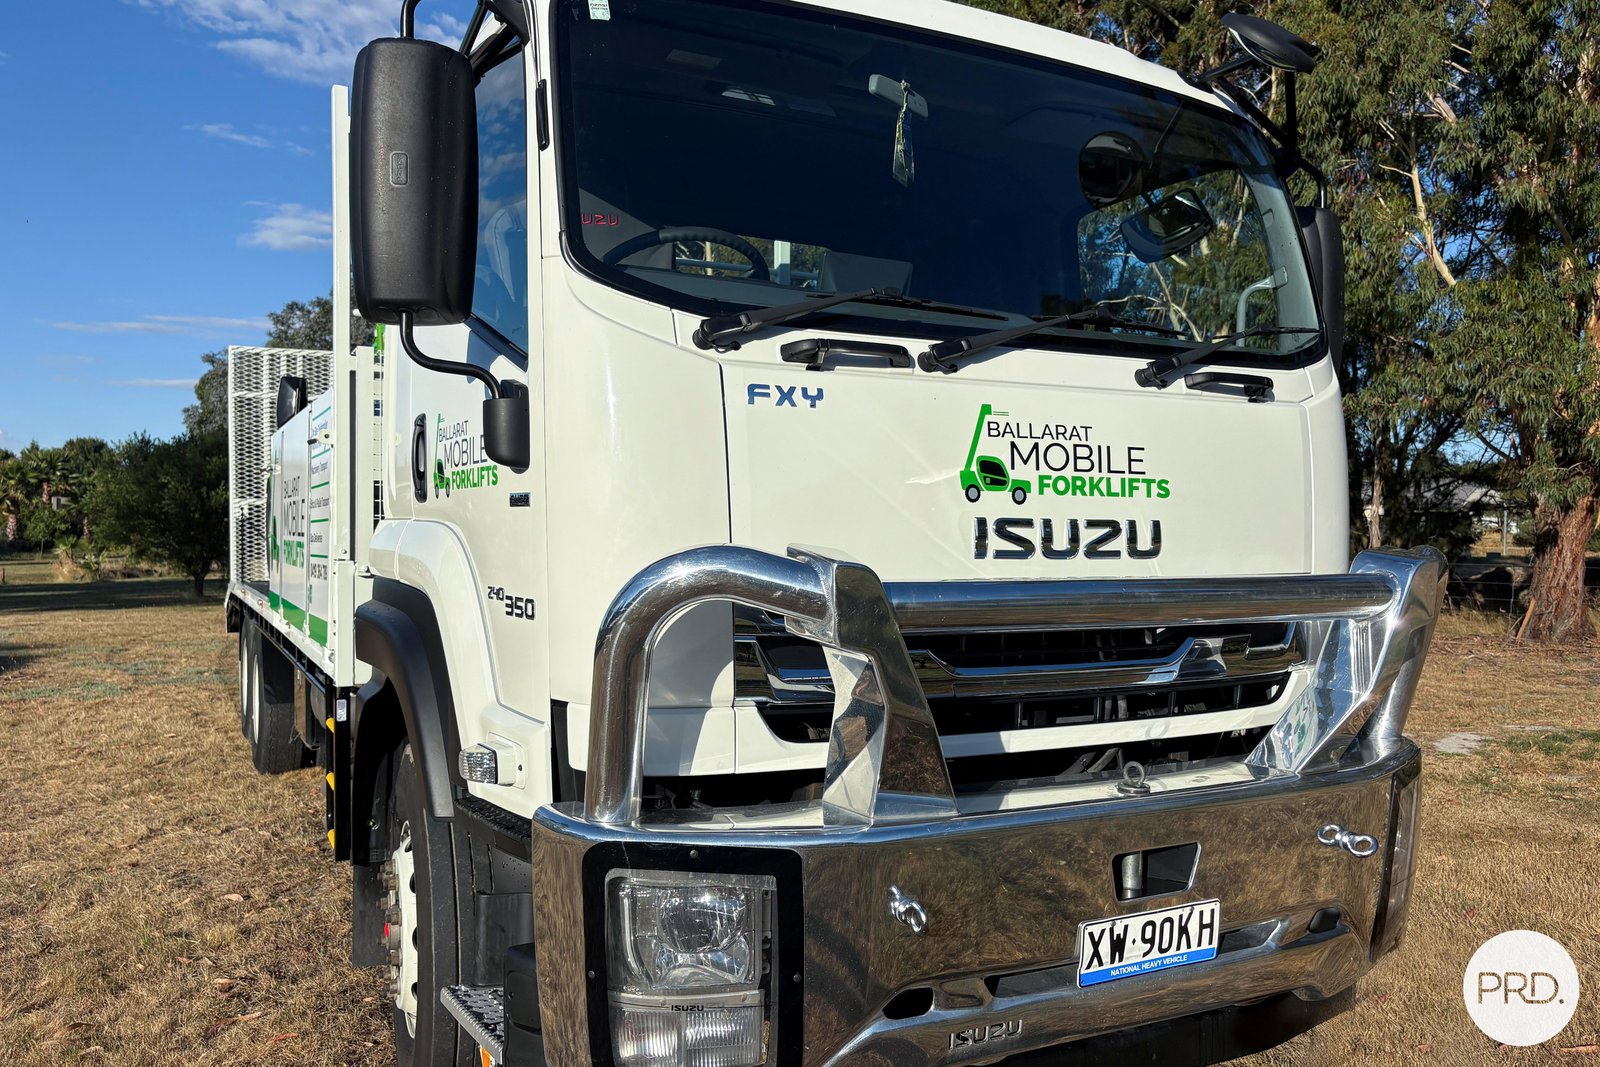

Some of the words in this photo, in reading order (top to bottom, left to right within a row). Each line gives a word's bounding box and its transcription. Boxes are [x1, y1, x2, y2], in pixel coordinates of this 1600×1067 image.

[747, 383, 824, 409] FXY
[438, 420, 469, 443] BALLARAT
[987, 421, 1092, 442] BALLARAT
[444, 434, 488, 470] MOBILE
[1010, 441, 1146, 475] MOBILE
[452, 464, 498, 490] FORKLIFTS
[1038, 474, 1171, 499] FORKLIFTS
[283, 498, 305, 537] MOBILE
[974, 517, 1162, 560] ISUZU
[1110, 965, 1141, 977] NATIONAL
[1141, 960, 1163, 970] HEAVY
[1163, 954, 1188, 965] VEHICLE
[671, 1004, 704, 1012] ISUZU
[949, 1019, 1023, 1050] ISUZU
